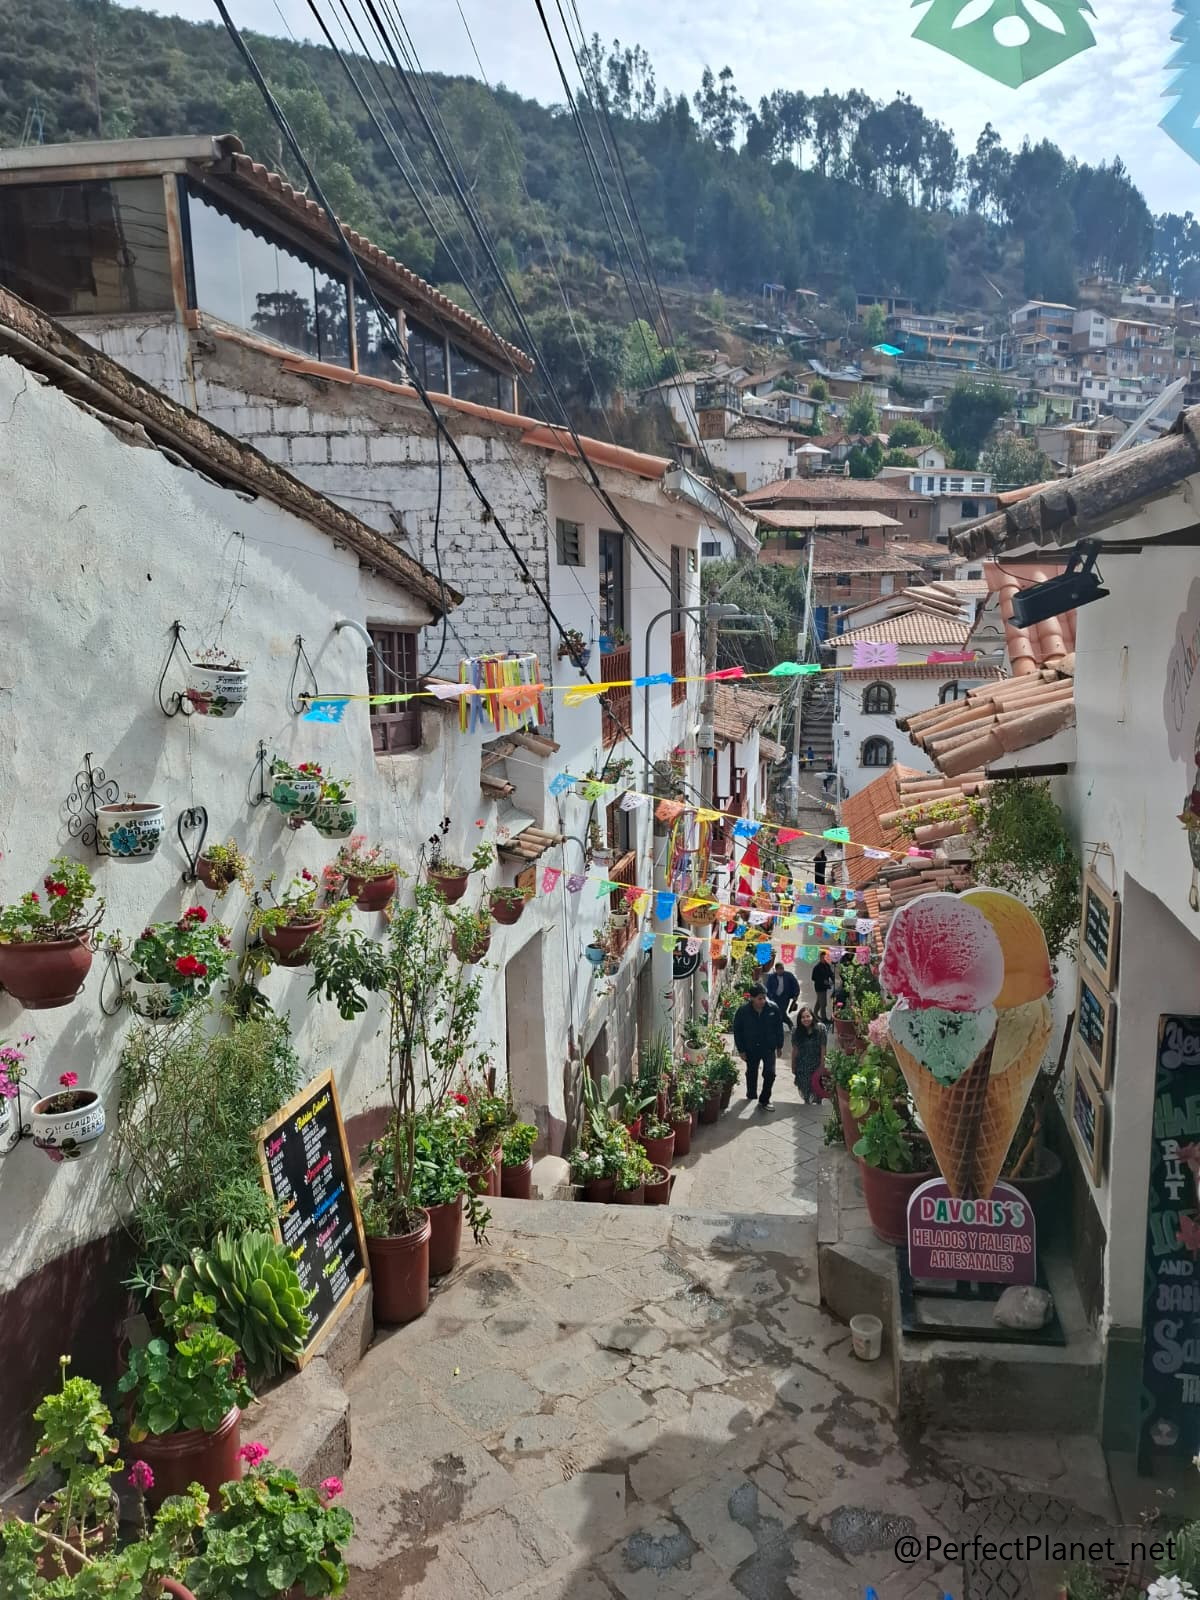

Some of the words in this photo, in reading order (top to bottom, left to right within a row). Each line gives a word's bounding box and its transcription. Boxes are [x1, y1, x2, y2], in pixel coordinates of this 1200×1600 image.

[913, 1228, 967, 1248] HELADOS
[968, 1232, 979, 1250] Y
[979, 1232, 1031, 1254] PALETAS
[929, 1250, 1015, 1273] ARTESANALES
[1157, 1259, 1193, 1276] AND
